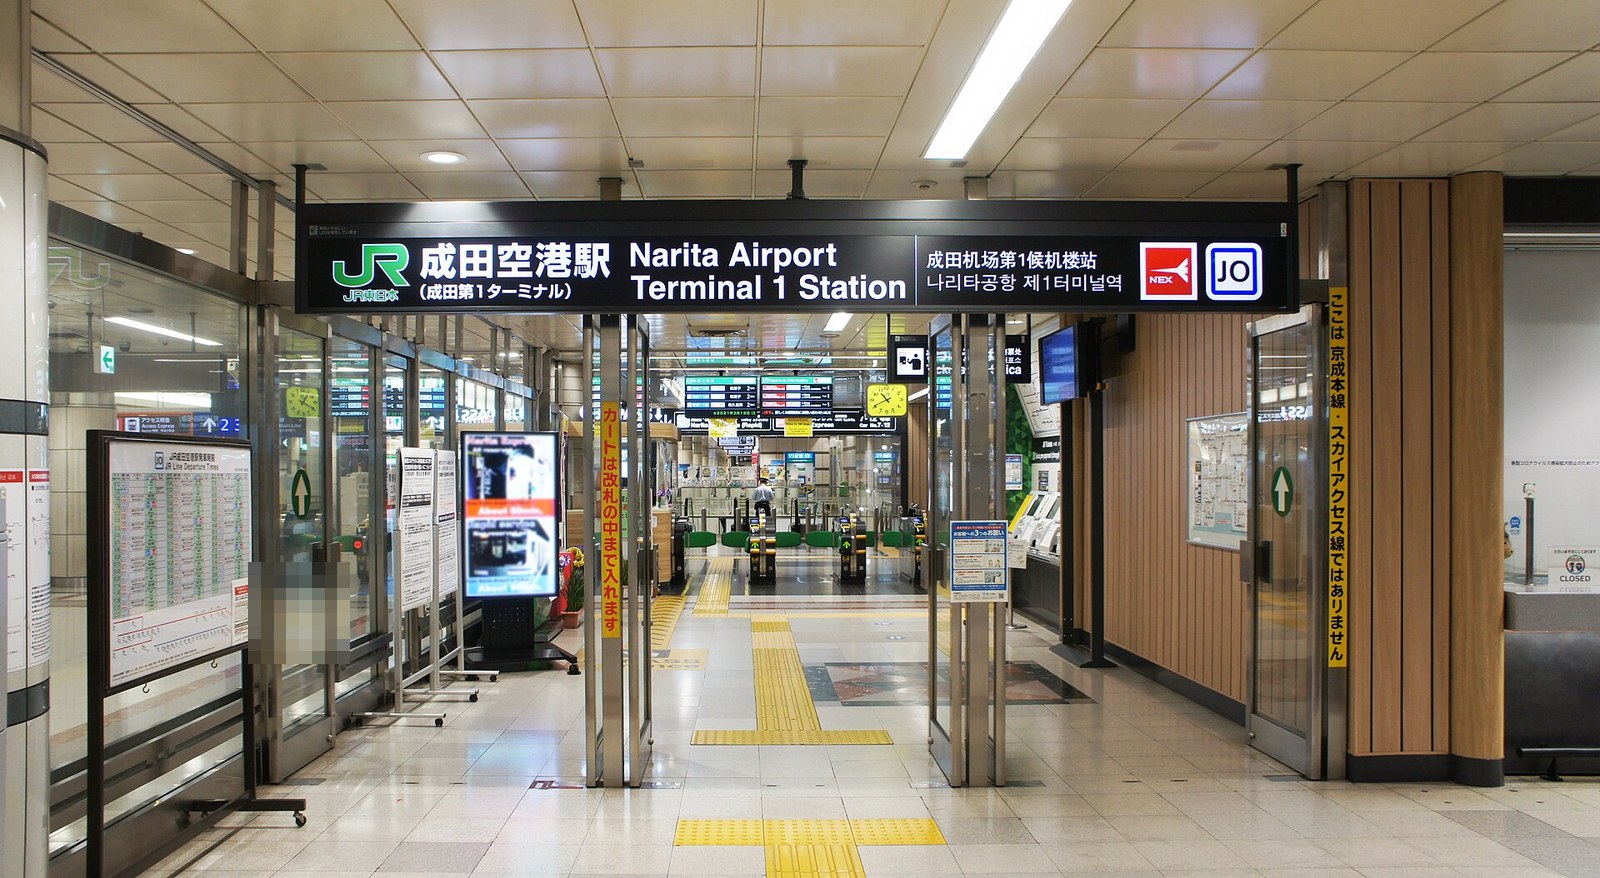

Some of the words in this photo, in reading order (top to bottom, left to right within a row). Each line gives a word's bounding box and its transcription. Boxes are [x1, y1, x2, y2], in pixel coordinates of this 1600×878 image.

[332, 243, 411, 288] JR
[420, 242, 611, 281] 成田空港駅
[629, 242, 719, 268] Narita
[729, 242, 837, 273] Airport
[926, 250, 1097, 270] 成田机场第1候机楼站
[1149, 275, 1174, 284] NEX
[1217, 260, 1250, 283] JO
[630, 274, 762, 300] Terminal
[773, 275, 785, 300] 1
[798, 274, 906, 300] Station
[926, 273, 1017, 292] 나리타공항
[1023, 273, 1122, 292] 제1터미널역
[343, 288, 399, 302] JR東日本
[220, 418, 229, 432] 2
[173, 462, 182, 470] Line
[184, 462, 206, 472] Departure
[206, 463, 219, 471] Times
[602, 407, 619, 632] カートは改札の中まで入れます
